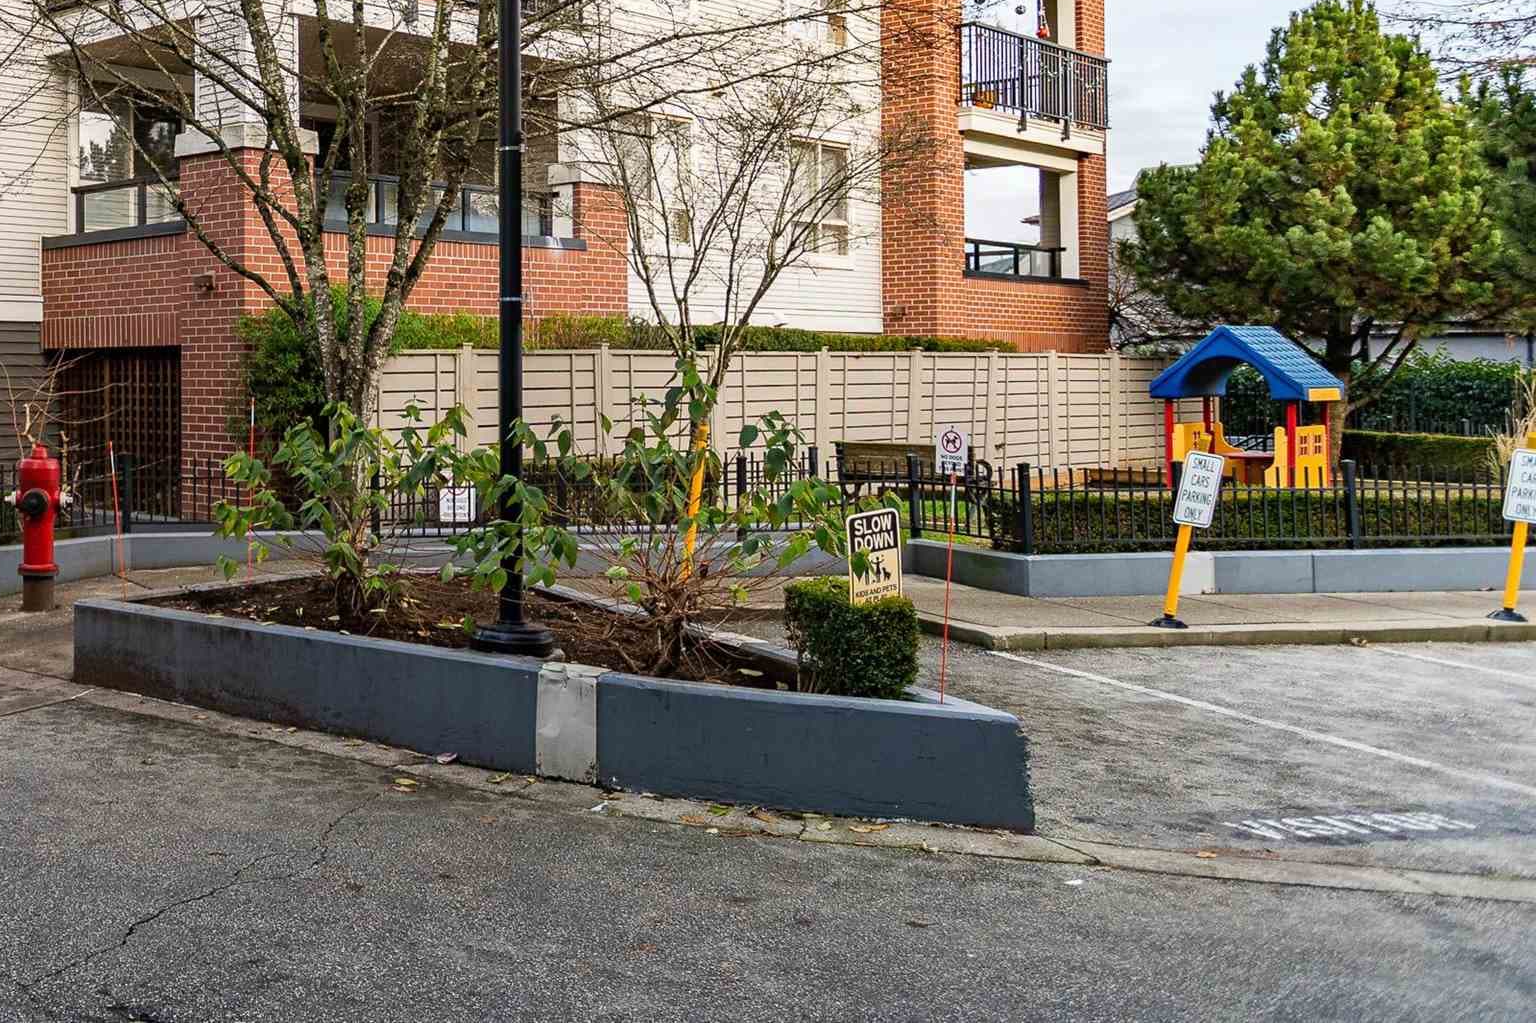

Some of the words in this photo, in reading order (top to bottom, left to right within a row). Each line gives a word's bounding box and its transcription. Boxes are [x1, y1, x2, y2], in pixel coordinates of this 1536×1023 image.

[1192, 457, 1216, 473] SMALL
[1191, 472, 1210, 488] CARS
[1182, 488, 1213, 506] PARKING
[1183, 506, 1203, 521] ONLY
[854, 513, 892, 536] SLOW
[854, 531, 894, 553] DOWN
[855, 589, 869, 598] KIDS
[869, 586, 882, 595] AND
[882, 583, 898, 593] PETS
[1222, 811, 1477, 840] VISITOR
